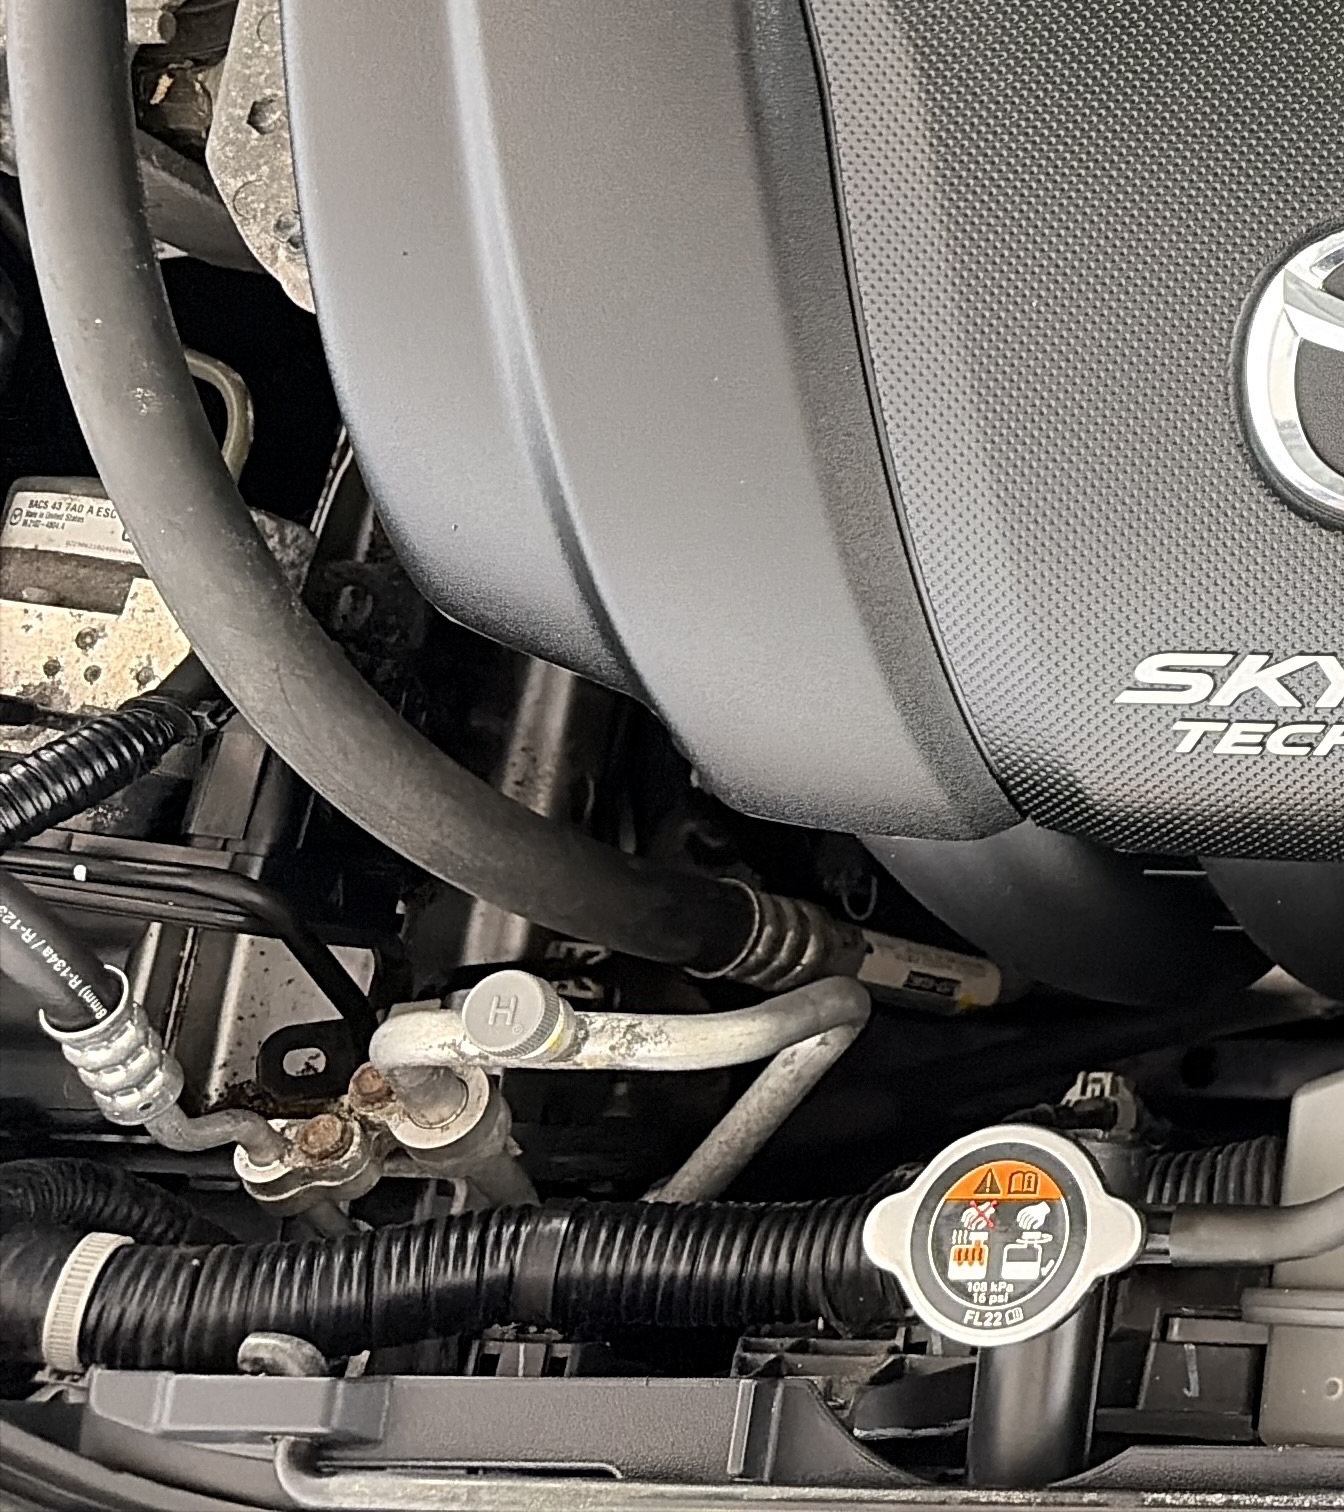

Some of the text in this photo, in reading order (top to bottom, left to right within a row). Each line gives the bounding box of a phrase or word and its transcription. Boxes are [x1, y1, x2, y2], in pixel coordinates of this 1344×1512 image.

[65, 513, 85, 523] States
[42, 945, 83, 989] R-134a
[488, 994, 518, 1026] H
[967, 1281, 1014, 1293] 108 kPa
[963, 1309, 1002, 1327] FL22
